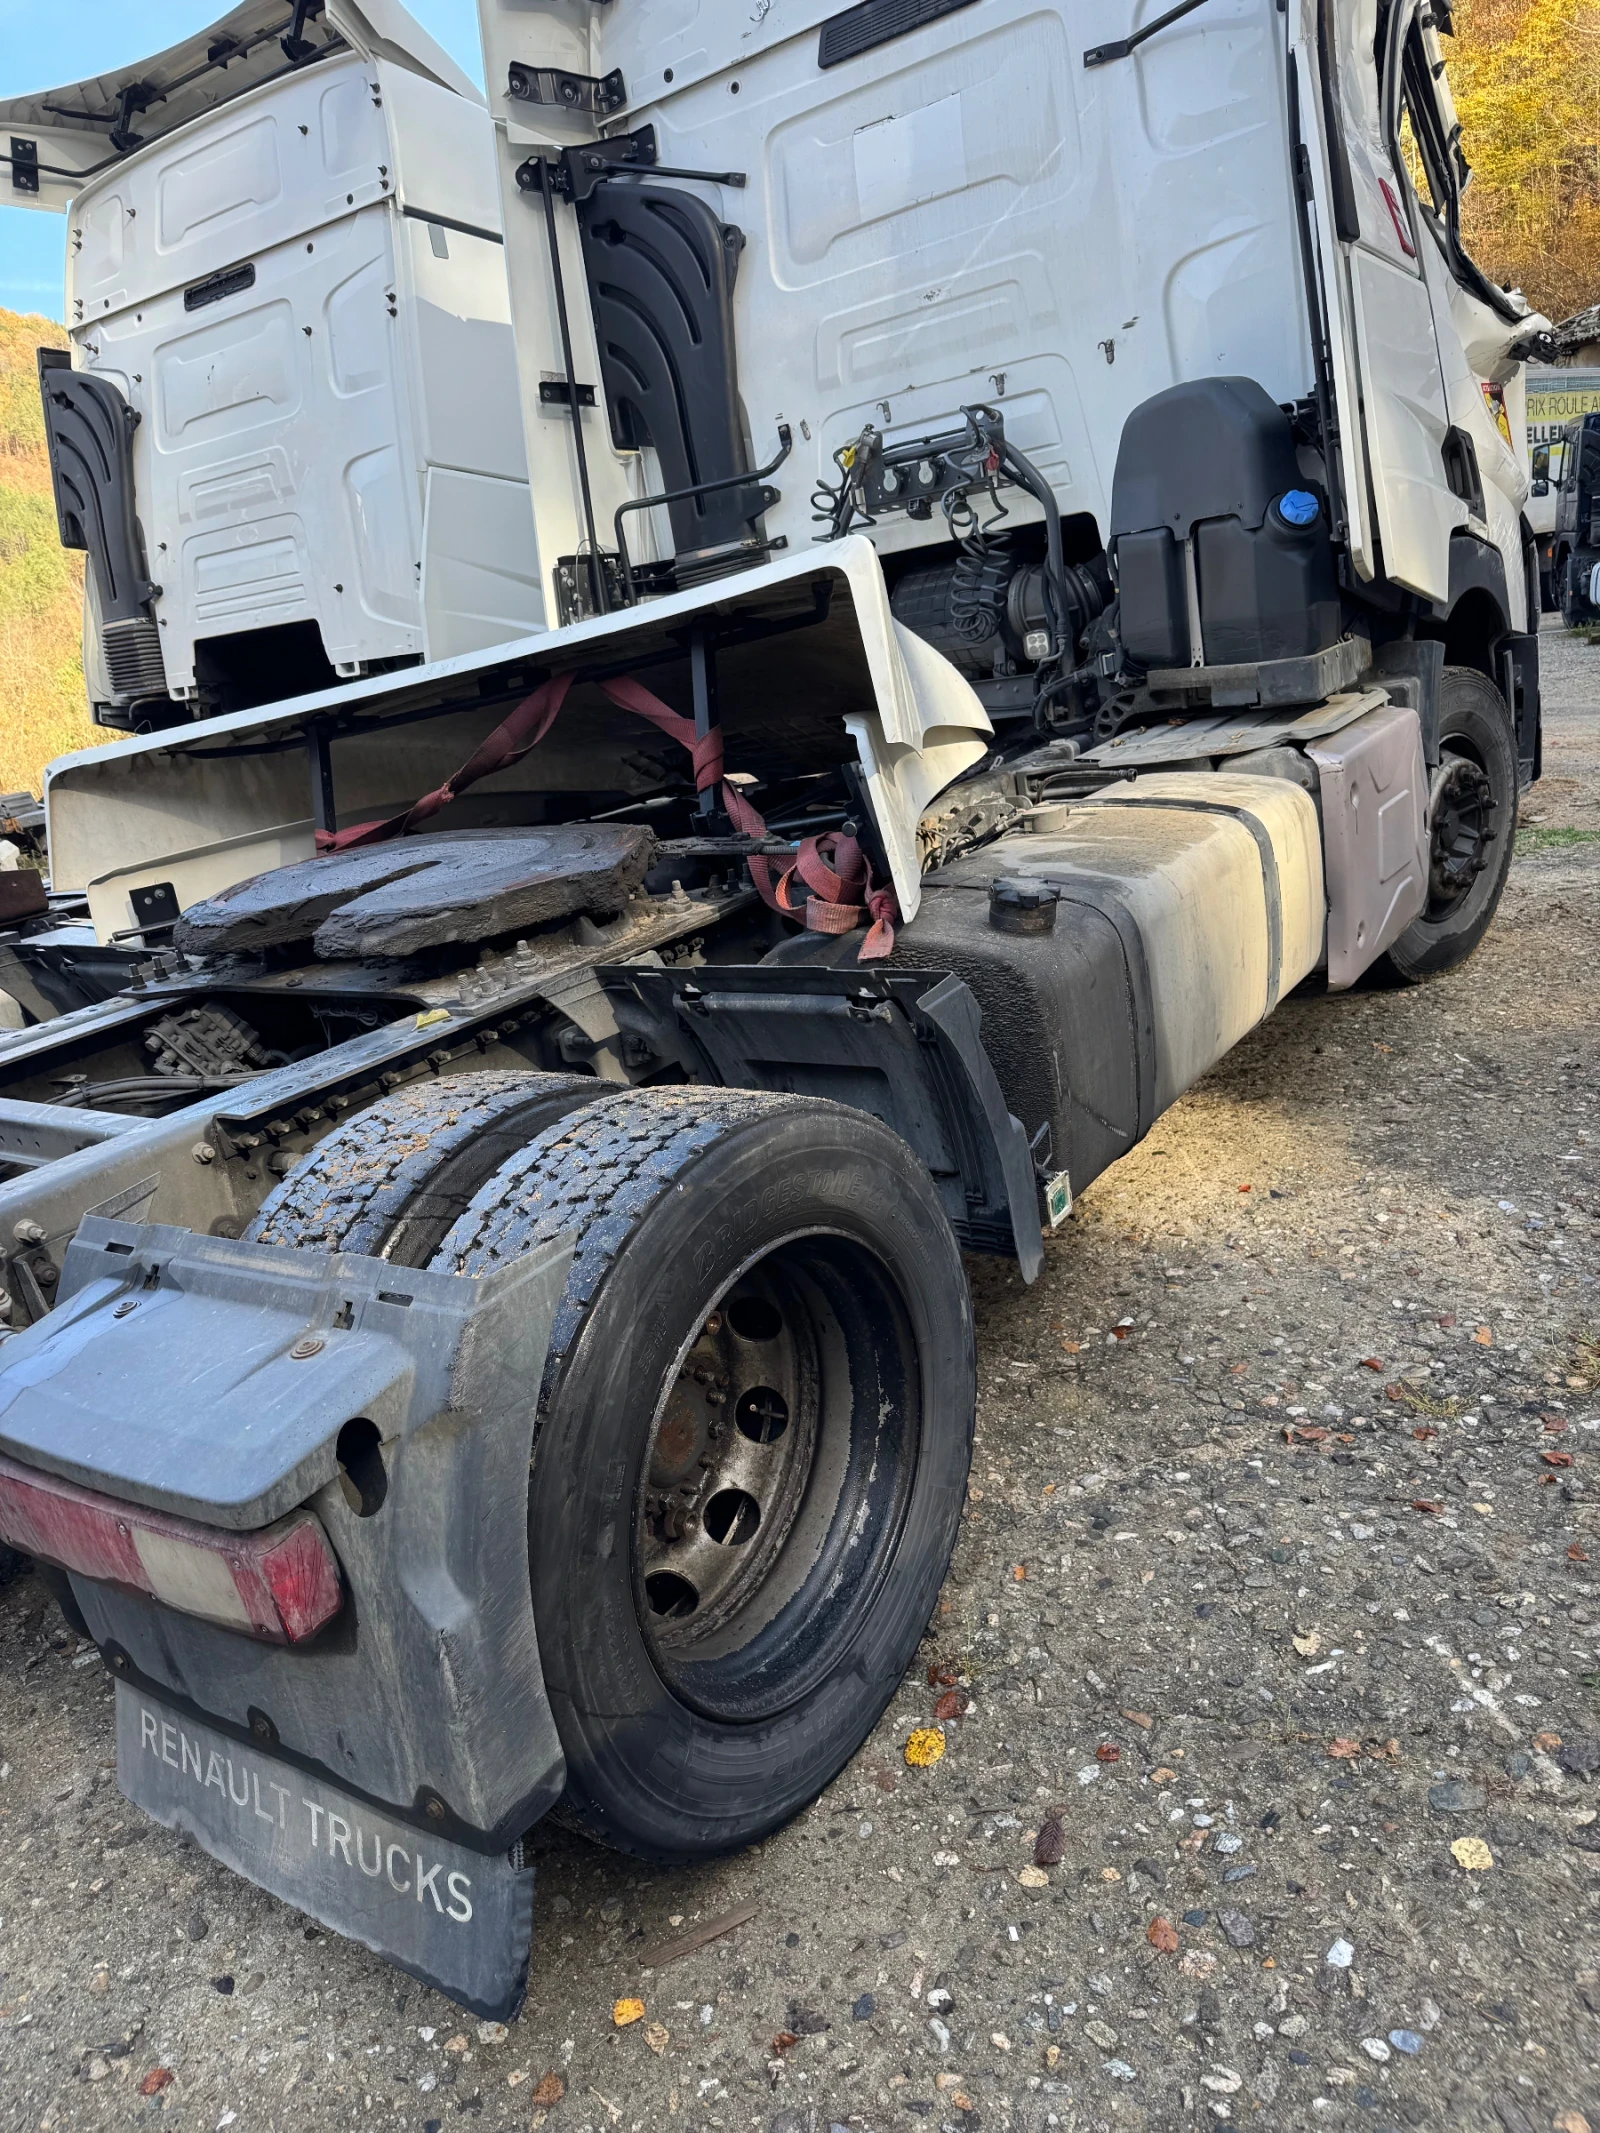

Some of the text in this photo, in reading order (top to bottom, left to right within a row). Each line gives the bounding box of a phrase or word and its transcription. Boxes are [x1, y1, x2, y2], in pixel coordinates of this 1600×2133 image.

[1549, 396, 1588, 415] ROULE
[1591, 396, 1600, 413] A
[692, 1168, 864, 1287] BRIDGESTONE
[140, 1708, 473, 1923] RENAULT TRUCKS
